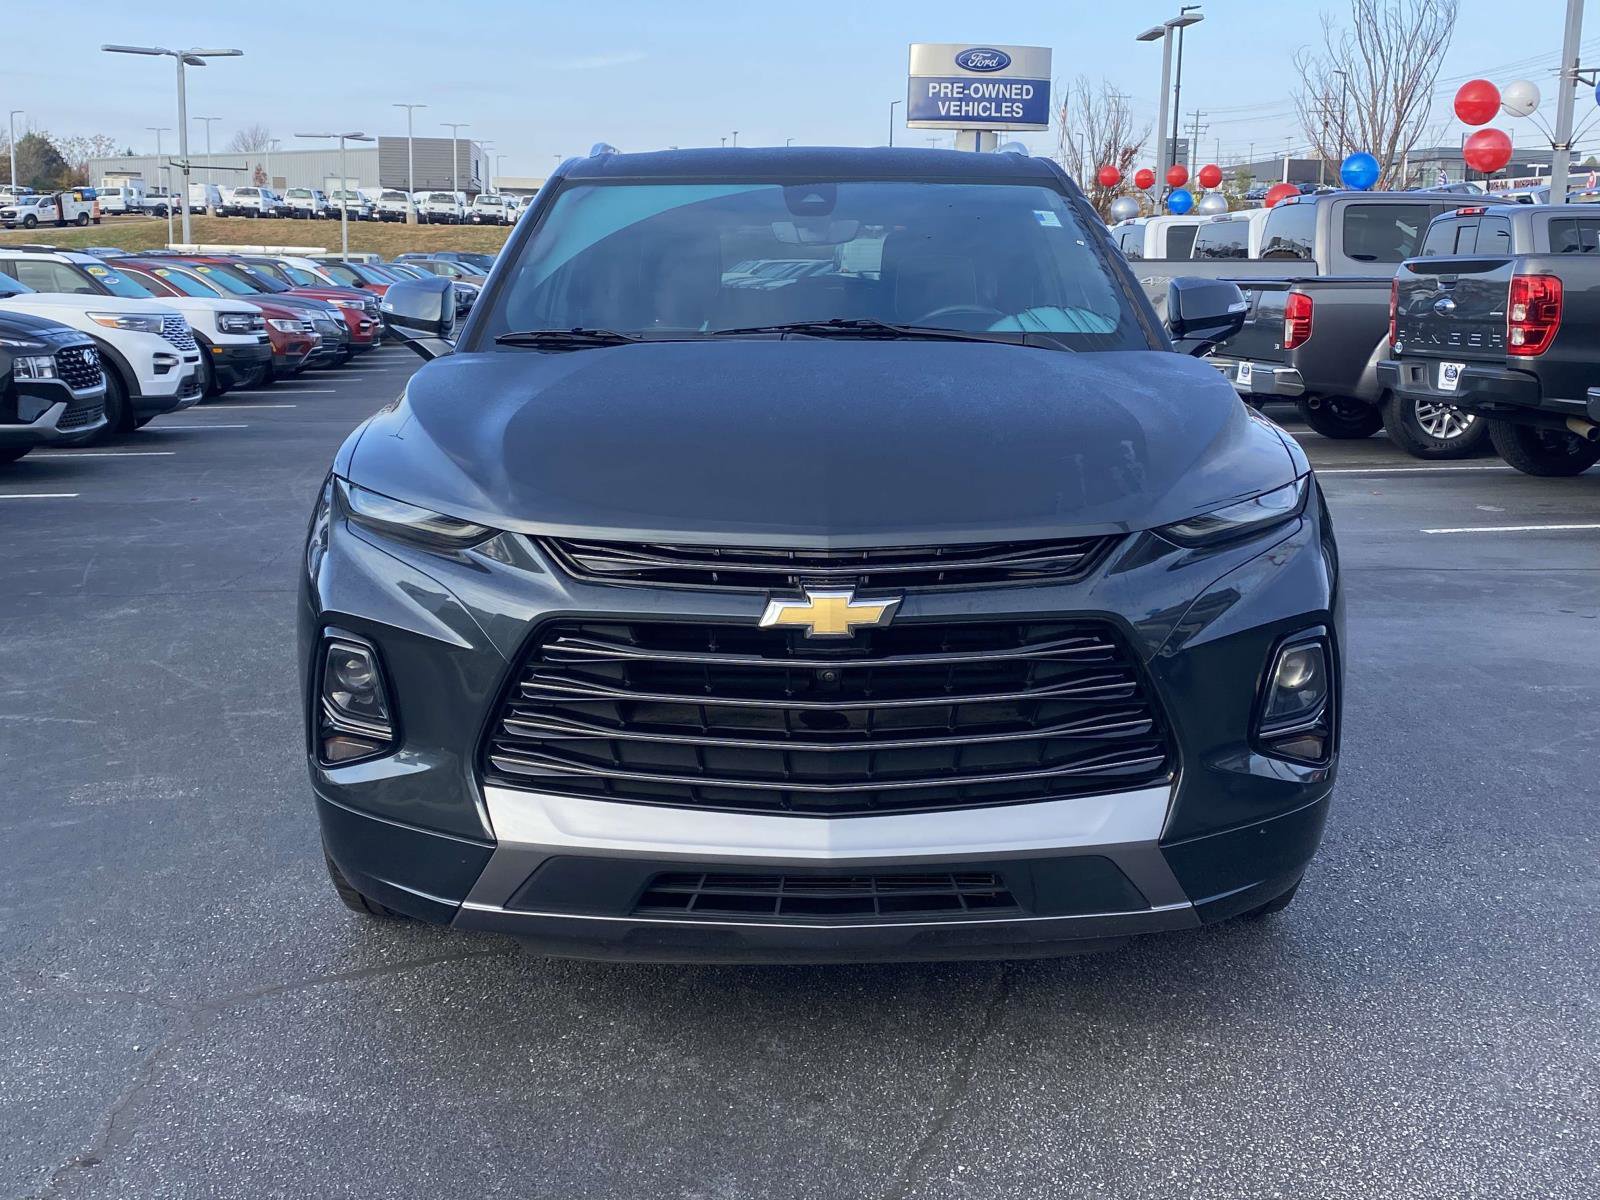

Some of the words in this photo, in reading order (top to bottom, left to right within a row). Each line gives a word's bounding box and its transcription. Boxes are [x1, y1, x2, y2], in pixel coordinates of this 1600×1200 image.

[968, 52, 999, 67] Ford
[928, 82, 1034, 99] PRE-OWNED
[938, 101, 1023, 117] VEHICLES
